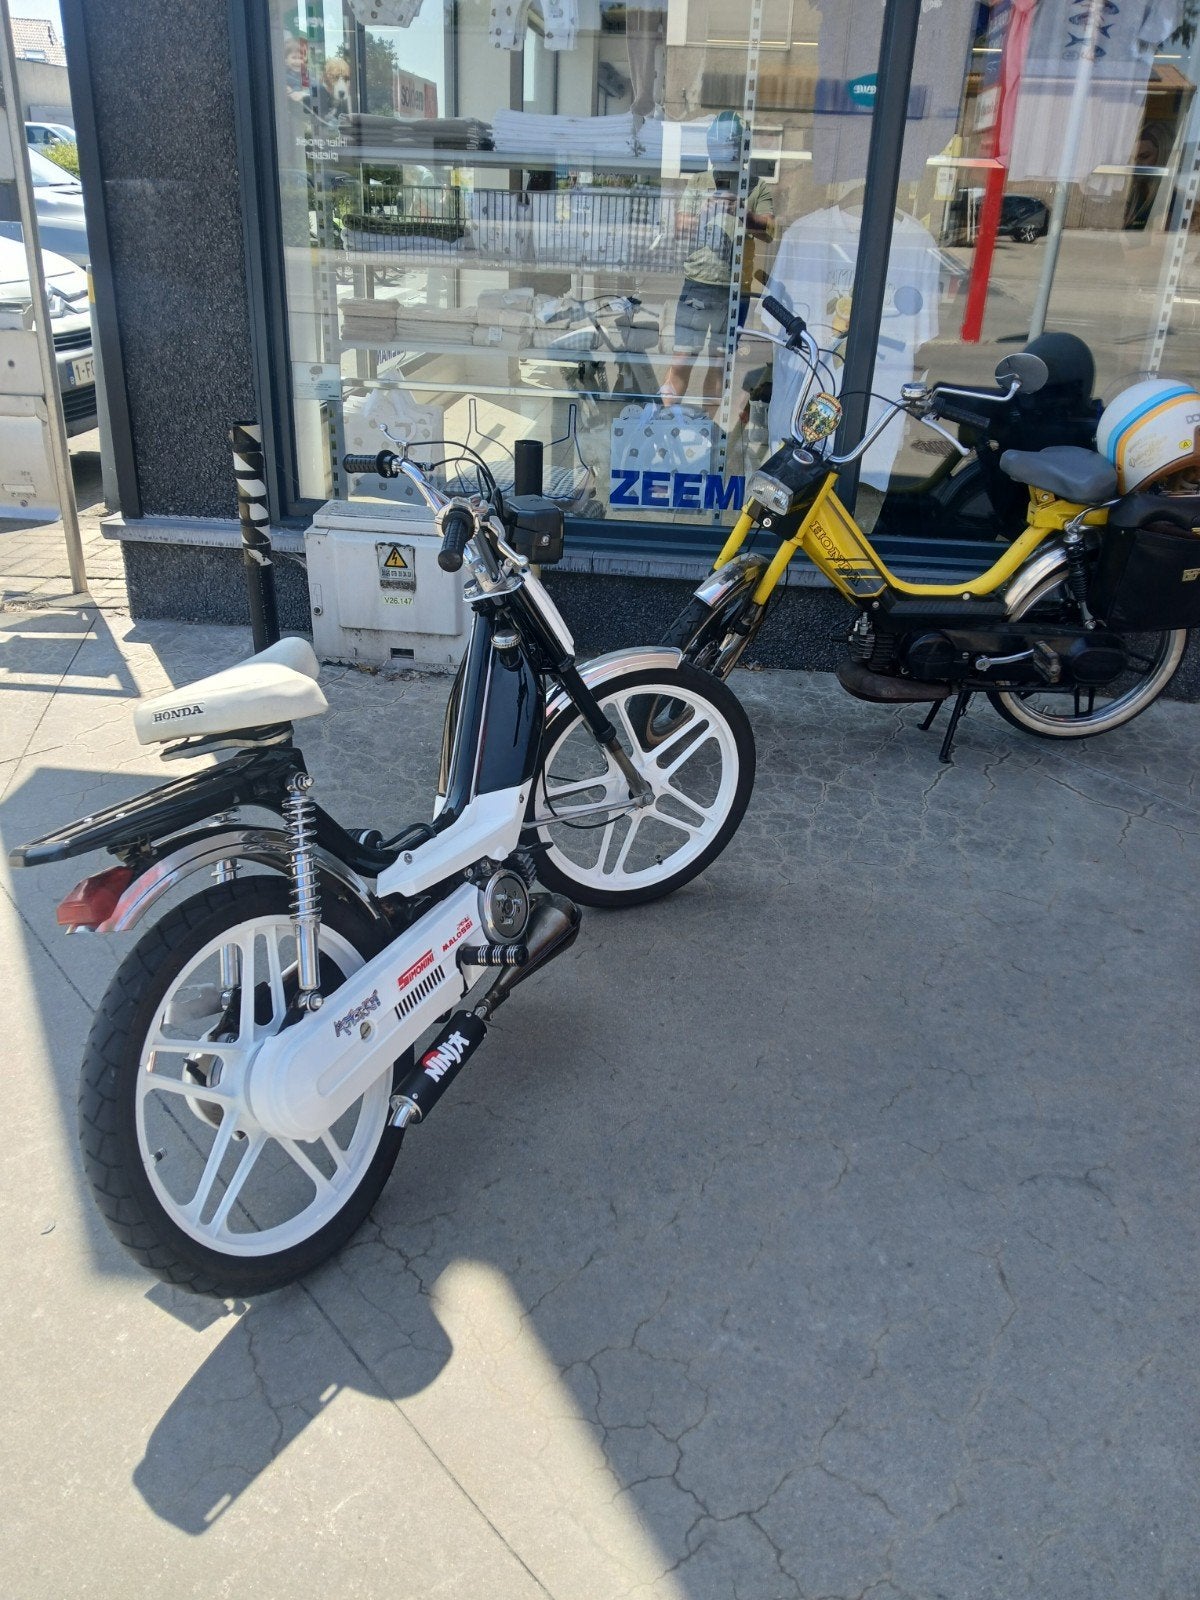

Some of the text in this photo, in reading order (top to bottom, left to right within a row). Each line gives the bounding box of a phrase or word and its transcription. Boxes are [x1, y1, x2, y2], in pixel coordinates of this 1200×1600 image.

[809, 520, 860, 587] HONDA
[153, 705, 204, 722] HONDA
[442, 920, 473, 952] MALOSSI
[424, 1031, 470, 1083] NINJA
